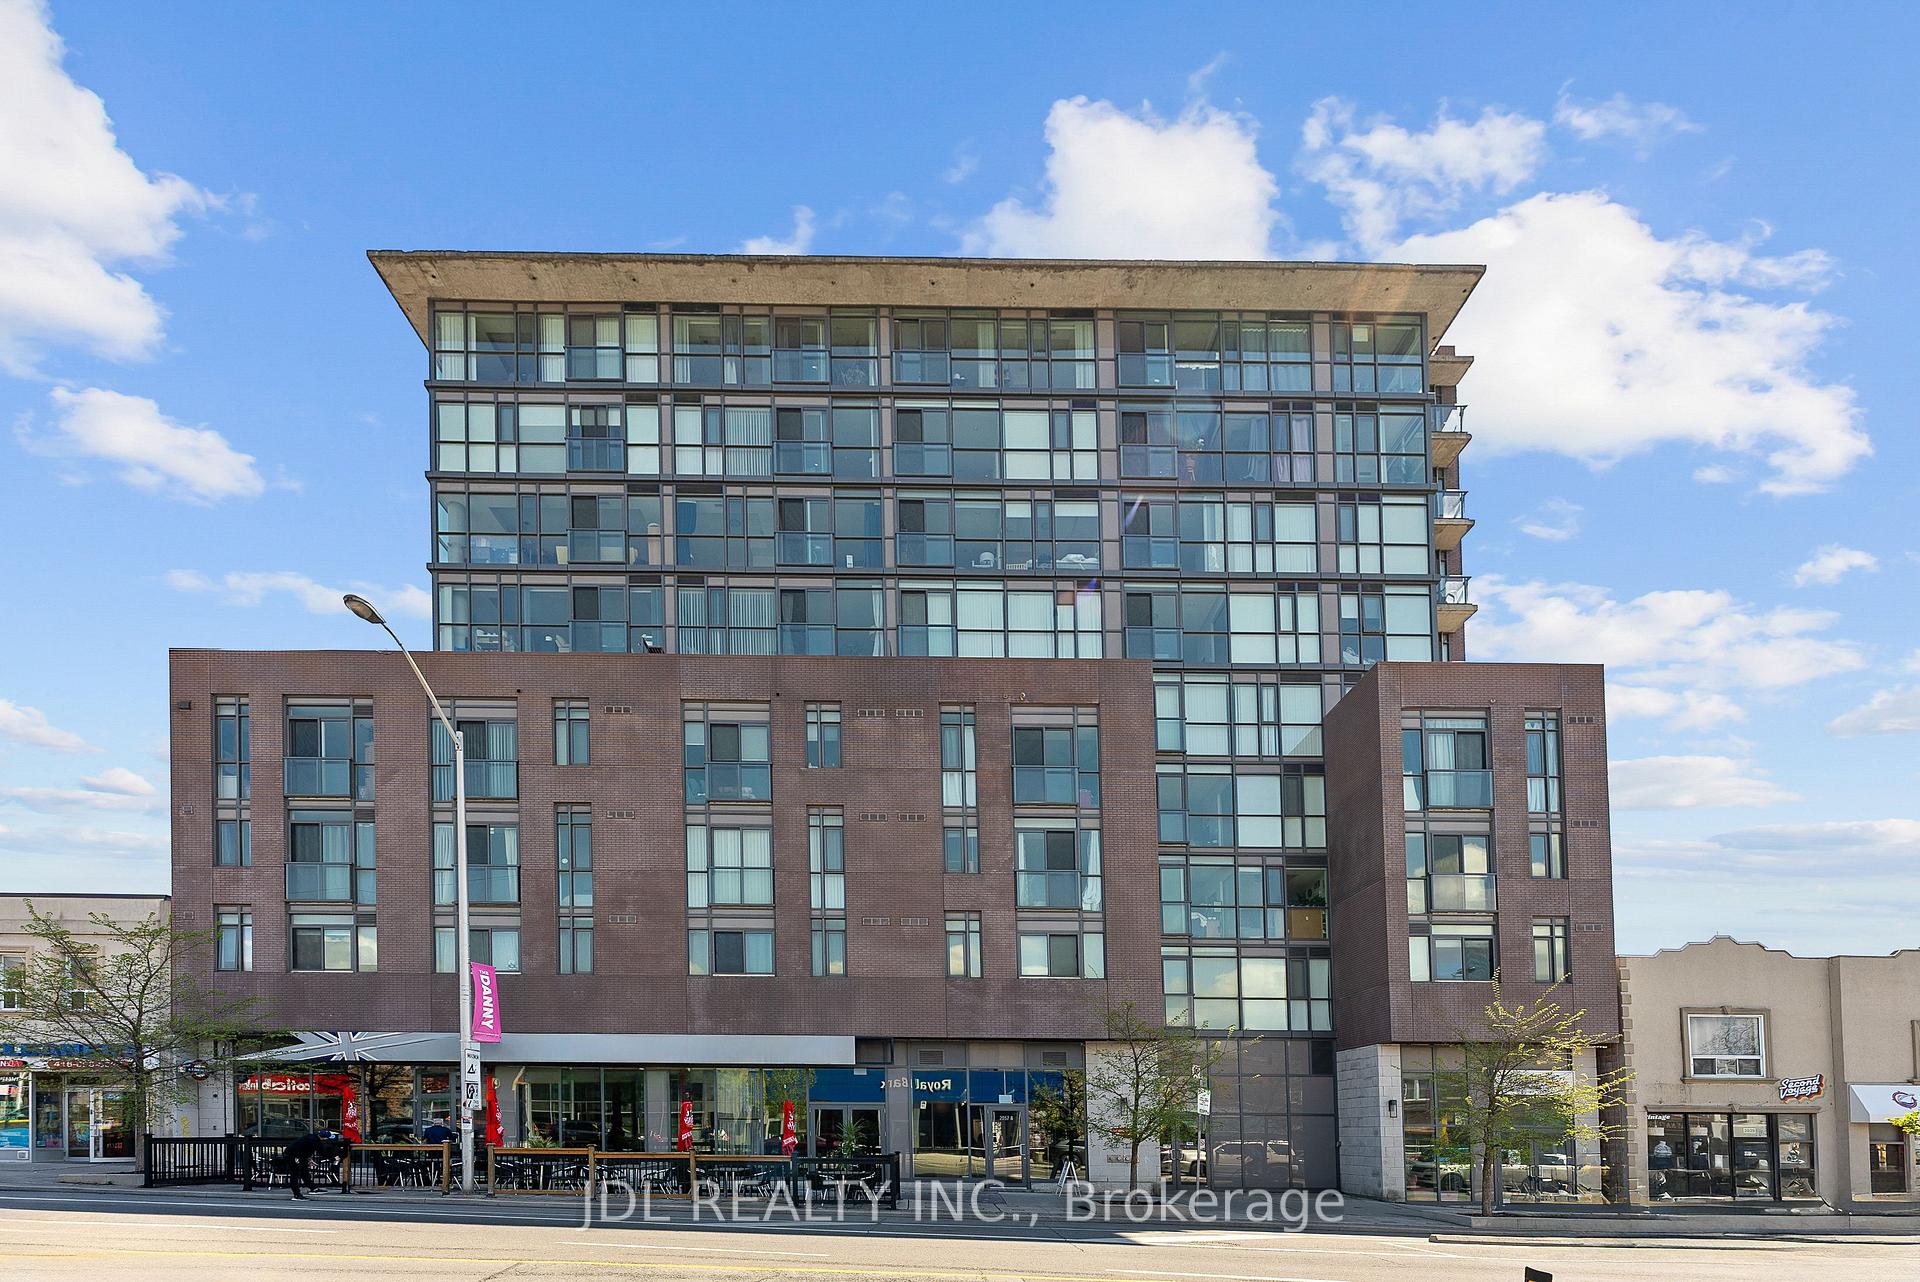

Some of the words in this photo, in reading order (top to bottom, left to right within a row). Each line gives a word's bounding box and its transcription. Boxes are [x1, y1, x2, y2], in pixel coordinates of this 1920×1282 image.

[480, 975, 494, 1029] DANNY
[1779, 1074, 1821, 1090] Second
[1780, 1084, 1820, 1099] Voyage
